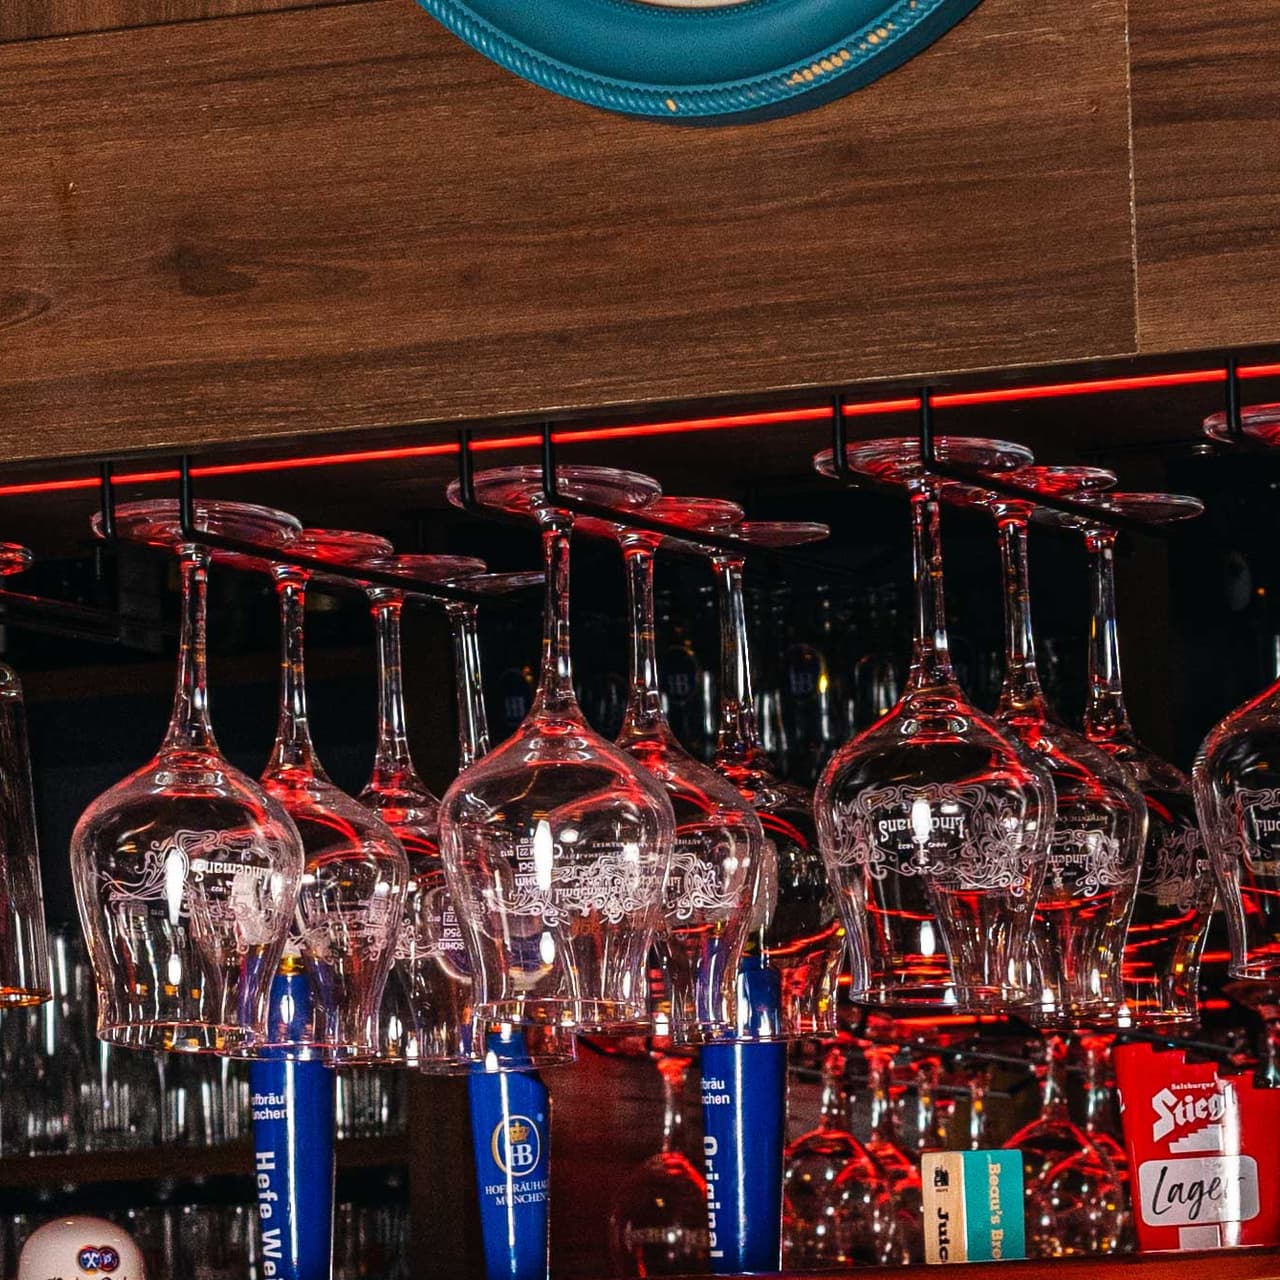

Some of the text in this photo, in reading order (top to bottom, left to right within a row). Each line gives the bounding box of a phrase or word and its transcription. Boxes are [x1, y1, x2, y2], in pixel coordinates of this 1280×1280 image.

[880, 815, 966, 842] Lindans
[256, 1151, 278, 1219] Hefe
[496, 1193, 546, 1206] MNCHEN
[988, 1163, 1003, 1225] Beau's
